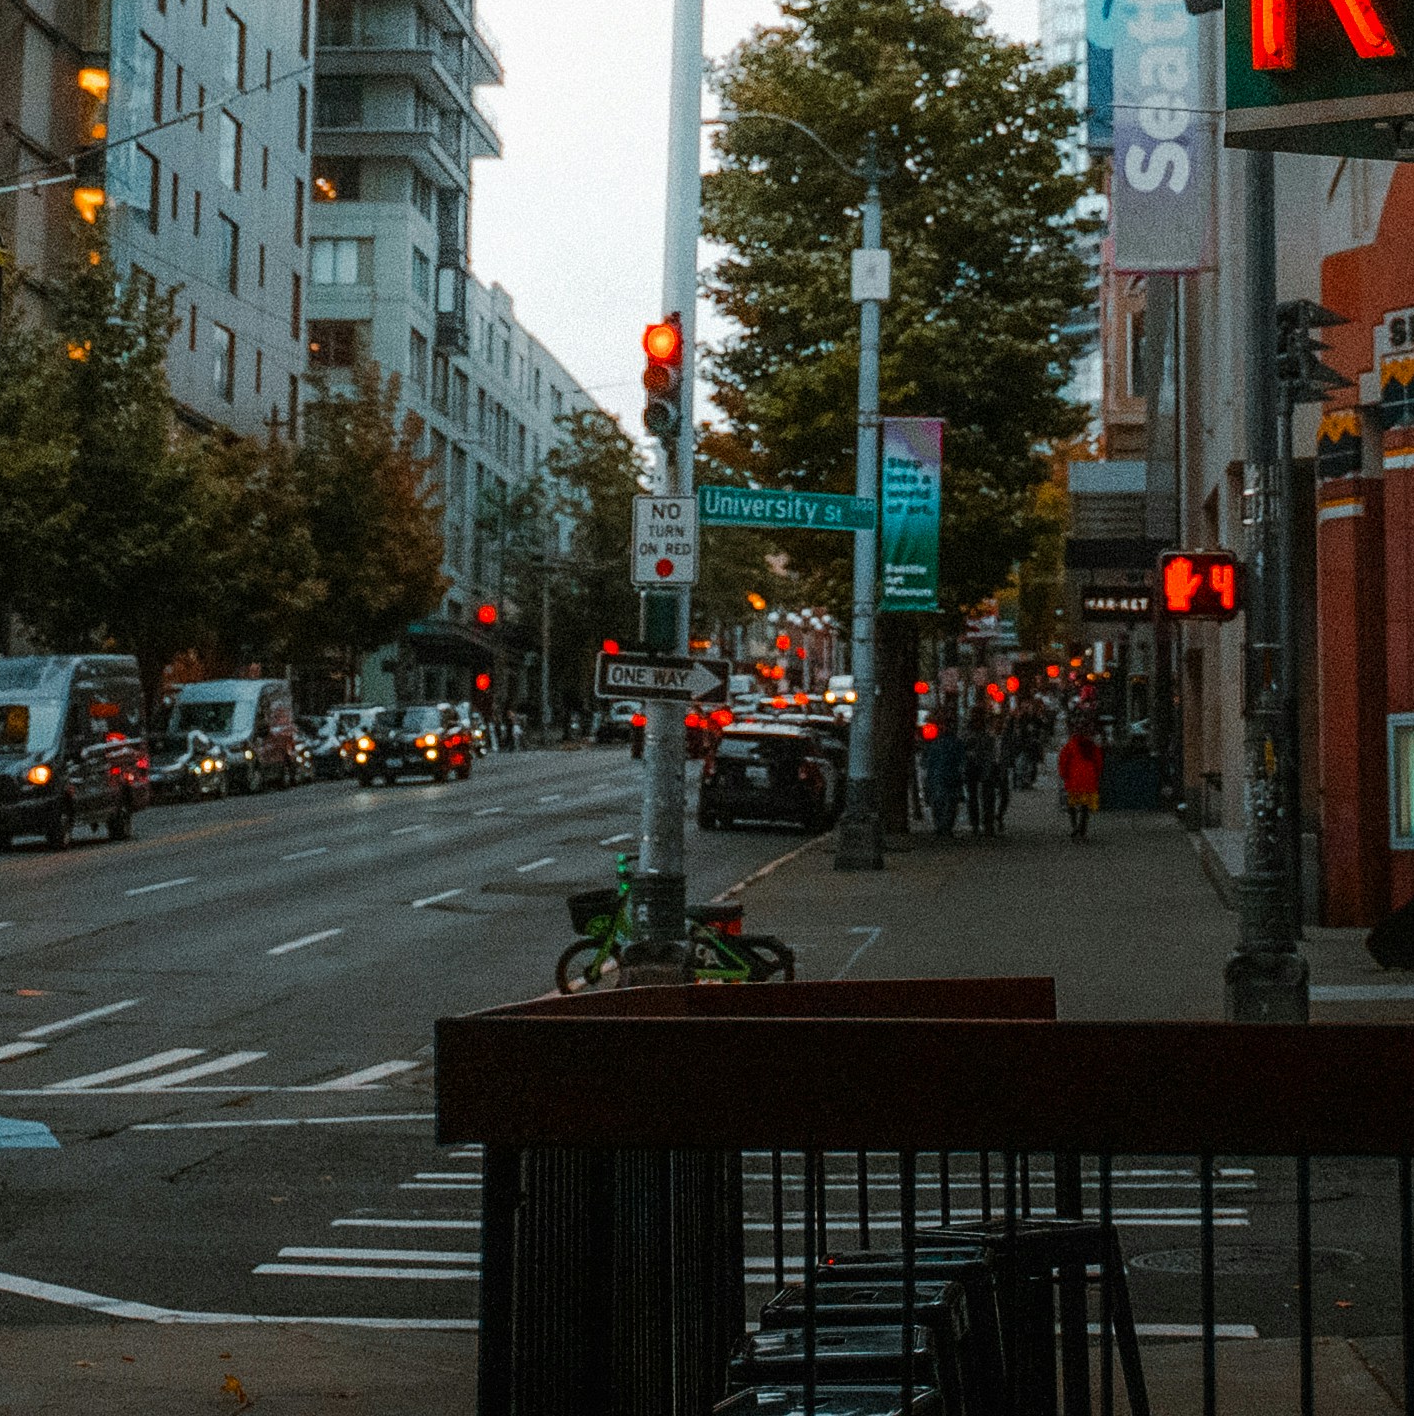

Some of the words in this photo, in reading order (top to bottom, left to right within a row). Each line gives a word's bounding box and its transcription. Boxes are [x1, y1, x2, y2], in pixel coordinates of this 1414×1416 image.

[652, 503, 682, 520] NO
[704, 489, 819, 526] University
[648, 525, 684, 538] TURN
[639, 542, 658, 555] ON
[665, 542, 691, 555] RED
[1210, 564, 1235, 610] 4
[611, 666, 647, 684] ONE
[653, 669, 689, 687] WAY
